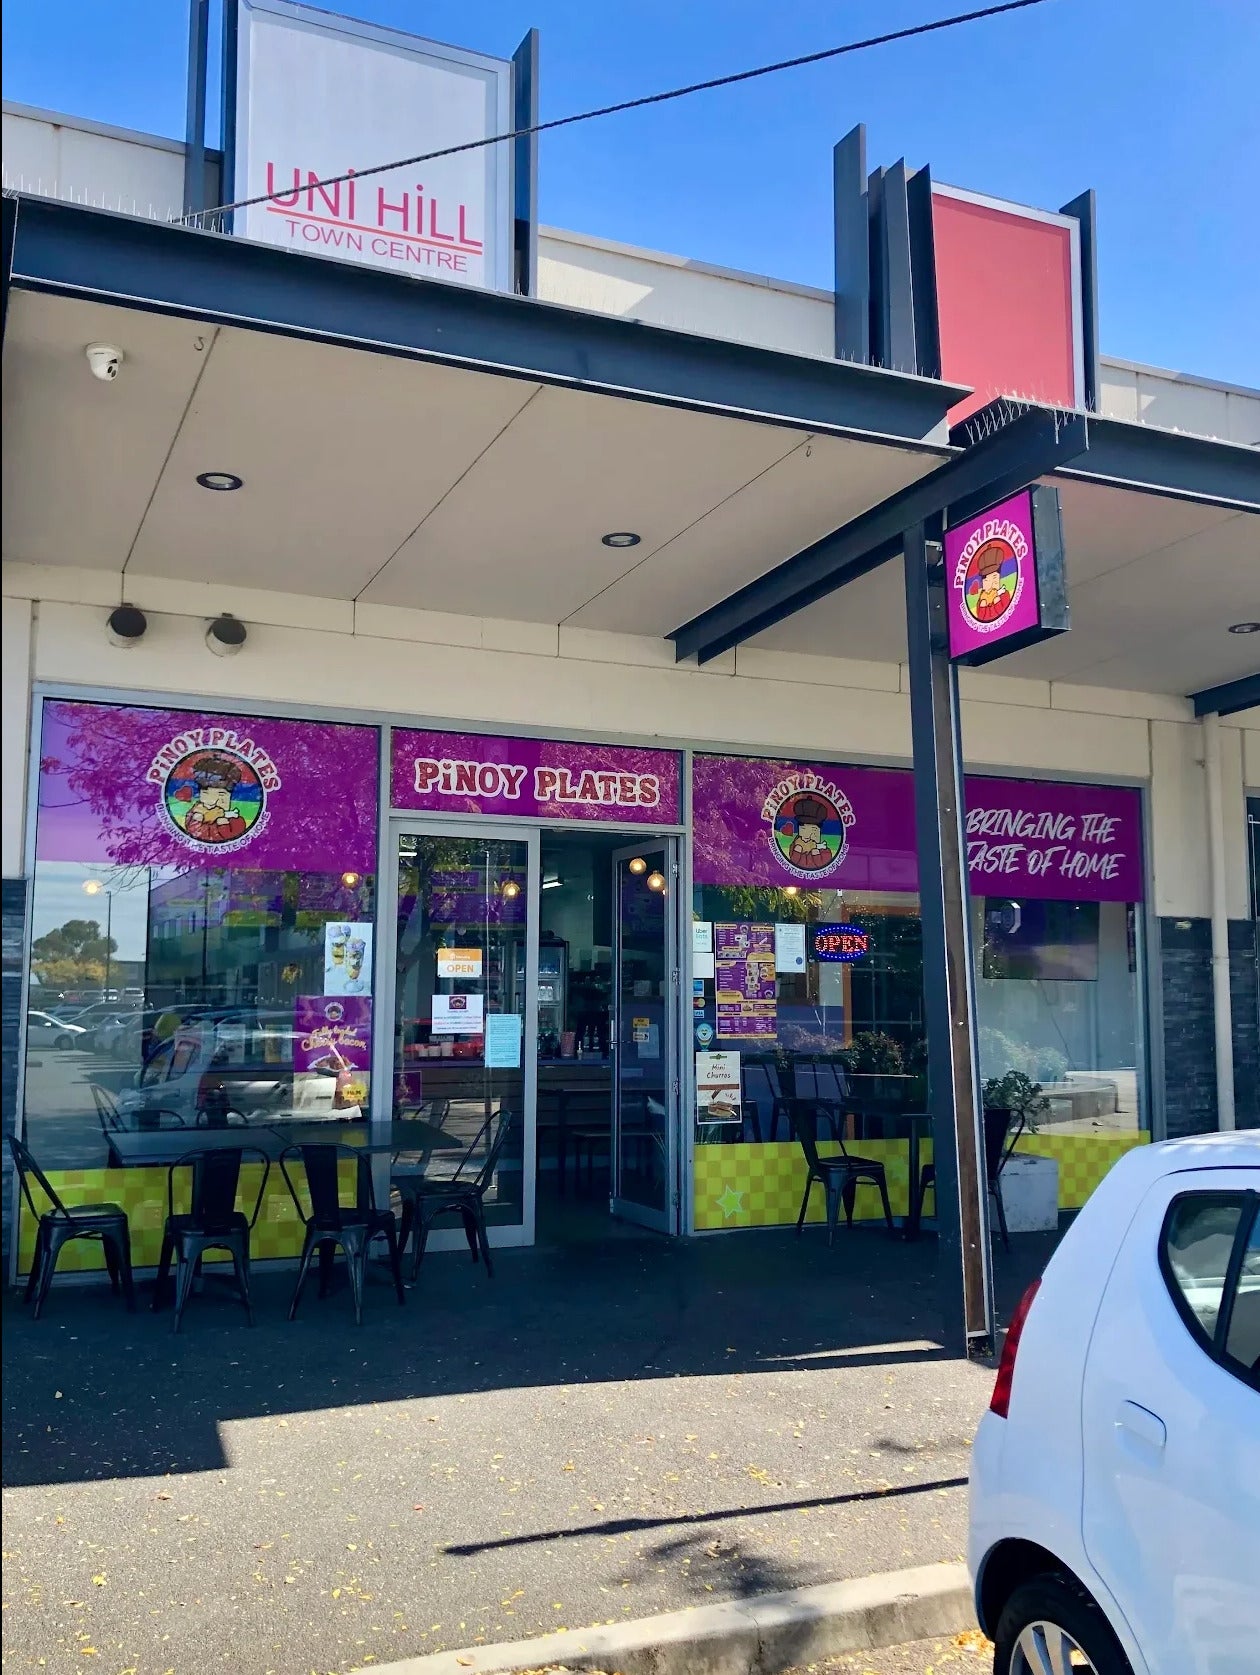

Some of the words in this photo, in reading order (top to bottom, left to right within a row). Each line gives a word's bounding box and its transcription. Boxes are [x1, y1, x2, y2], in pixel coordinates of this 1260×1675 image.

[285, 219, 362, 251] TOWN
[371, 238, 467, 273] CENTRE
[984, 519, 1028, 560] PLATES
[210, 728, 281, 791] PLATES
[534, 767, 660, 807] PLATES
[803, 773, 856, 827] PLATES
[156, 803, 185, 844] BRINGING
[206, 842, 240, 854] TASTE
[239, 833, 252, 847] OF
[250, 811, 271, 838] HOME
[966, 808, 1077, 841] BRINGING
[1081, 813, 1122, 844] THE
[768, 836, 791, 871] BRINGING
[789, 867, 804, 879] THE
[827, 862, 838, 874] OF
[835, 844, 850, 866] HOME
[1027, 846, 1066, 877] OF
[1059, 850, 1127, 880] HOME
[815, 935, 869, 952] OPEN
[447, 964, 474, 973] OPEN
[712, 1063, 726, 1071] Mini
